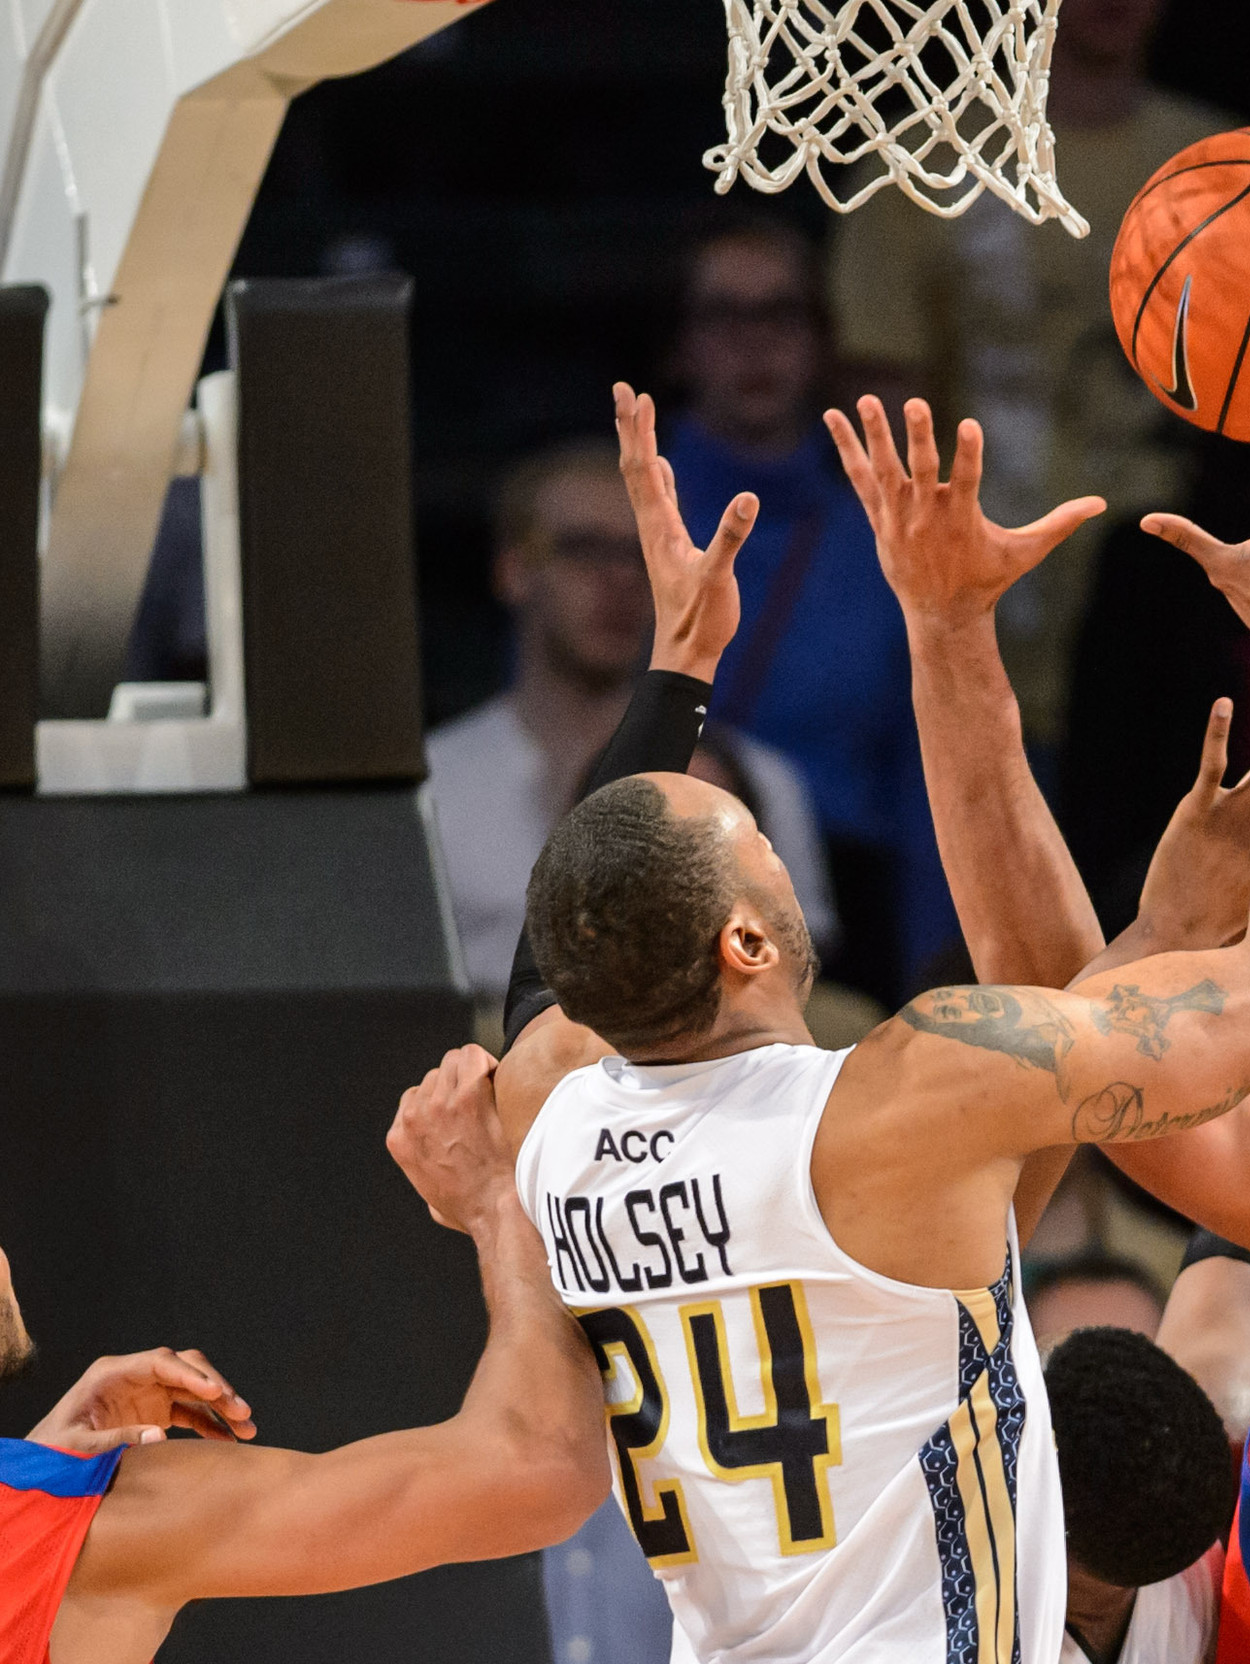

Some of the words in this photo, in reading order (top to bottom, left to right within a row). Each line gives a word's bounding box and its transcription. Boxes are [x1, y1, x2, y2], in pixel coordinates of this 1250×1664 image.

[594, 1128, 675, 1164] ACC
[546, 1174, 734, 1293] HOLSEY
[571, 1278, 843, 1570] 24
